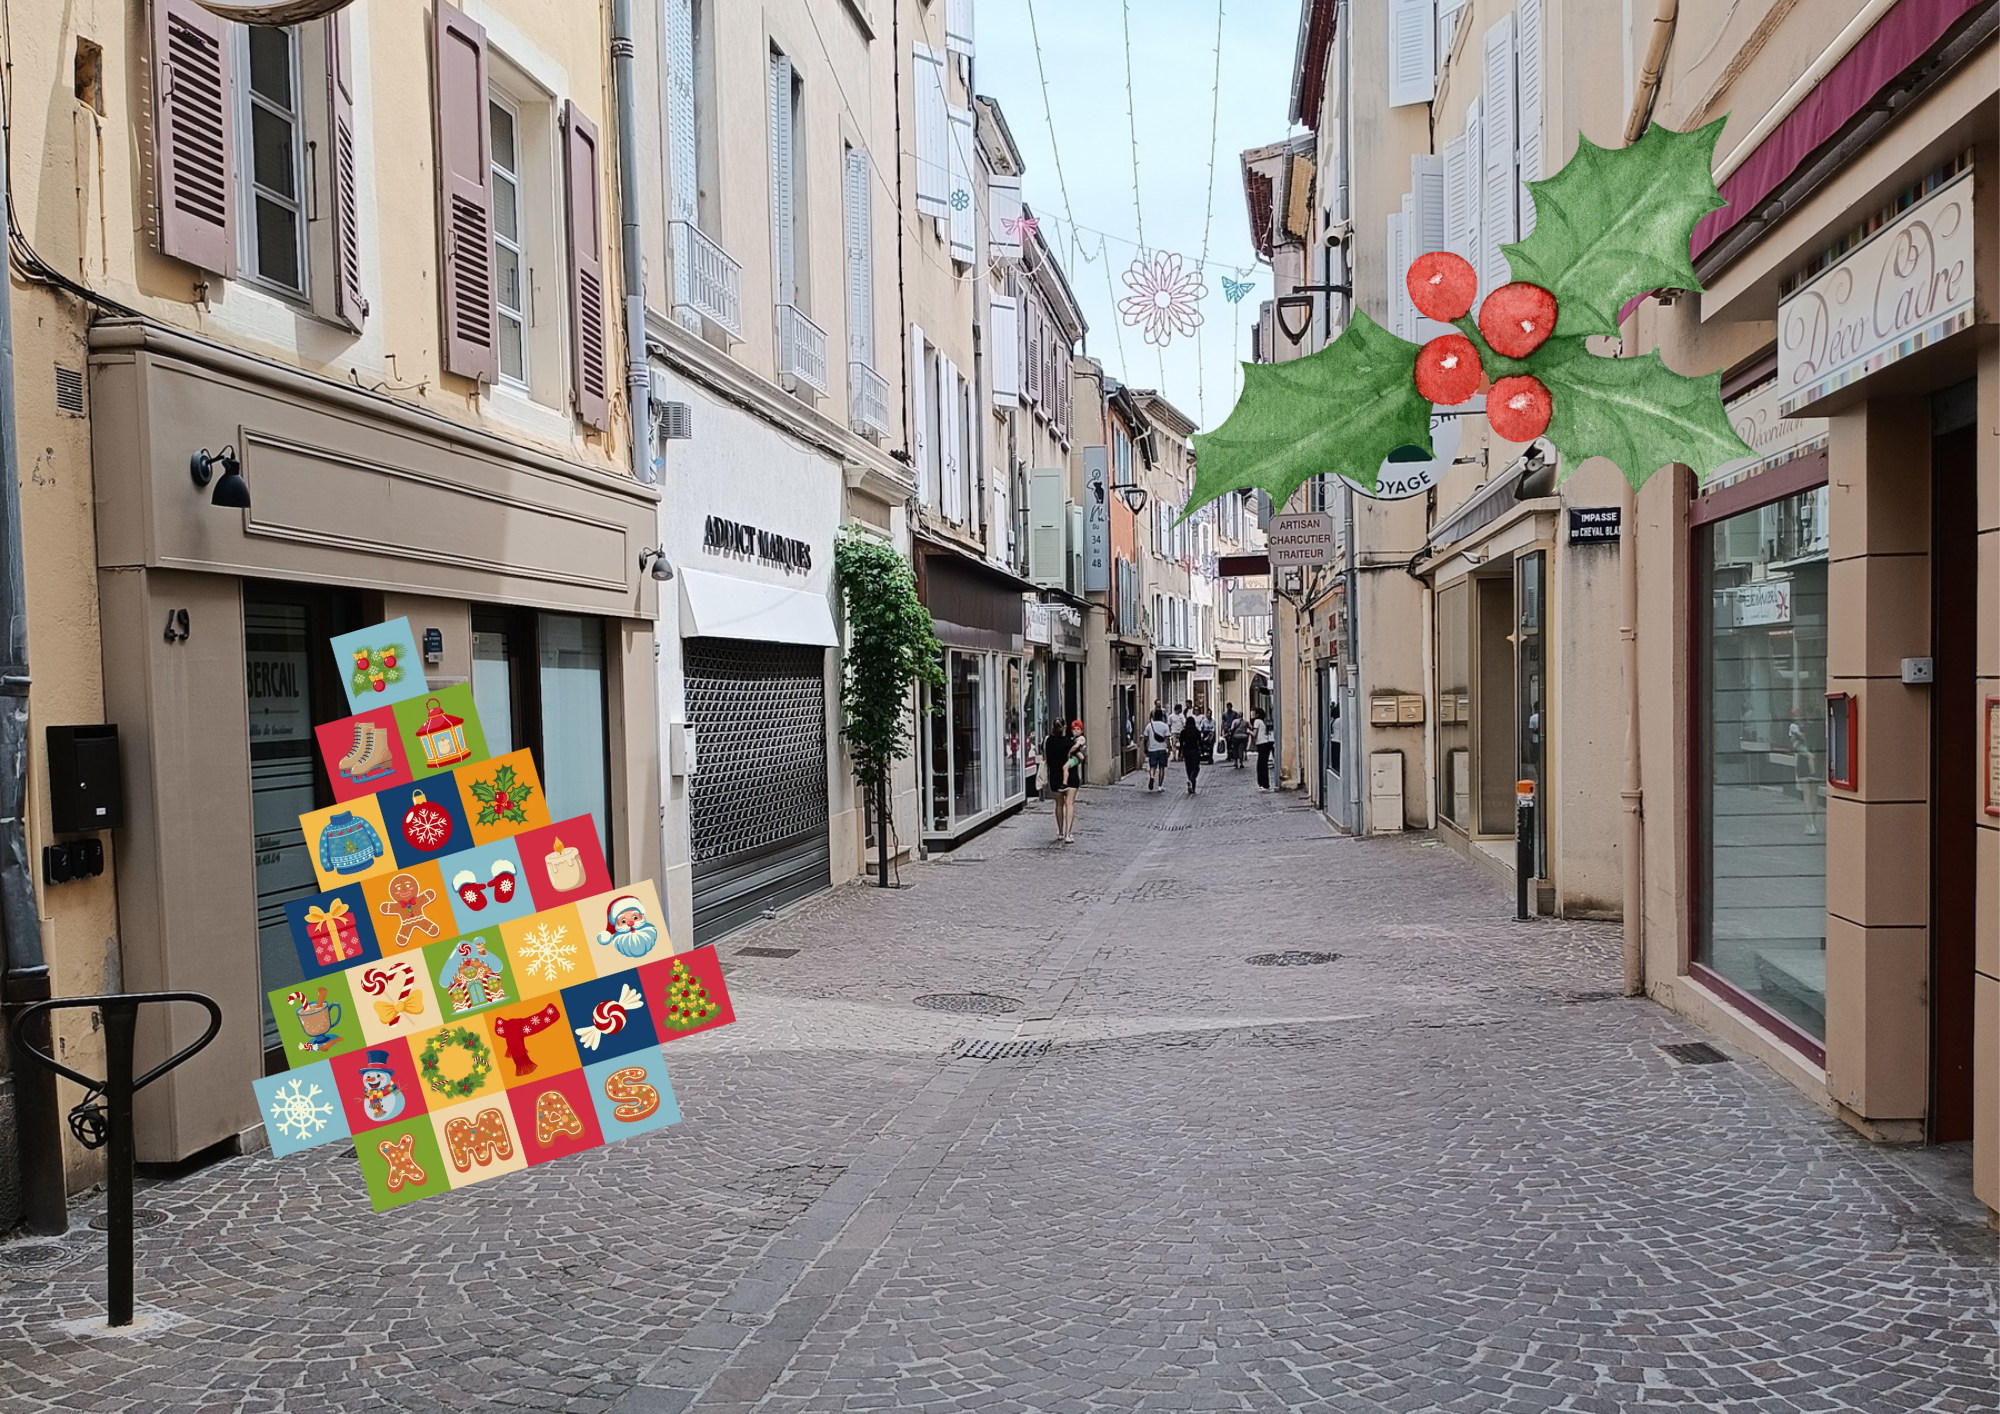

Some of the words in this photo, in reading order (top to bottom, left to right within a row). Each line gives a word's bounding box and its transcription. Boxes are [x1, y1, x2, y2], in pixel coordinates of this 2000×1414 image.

[1784, 267, 1869, 384] Déco
[1873, 202, 1964, 338] Cadre
[1362, 470, 1431, 495] OYAGE
[1581, 512, 1618, 523] IMPASSE
[1280, 519, 1320, 530] ARTISAN
[703, 514, 756, 555] ADDICT
[757, 529, 812, 570] MARQUES
[1091, 535, 1101, 544] 34
[1270, 534, 1331, 546] CHARCUTIER
[1278, 548, 1324, 560] TRAITEUR
[1091, 559, 1102, 568] 48
[163, 608, 190, 642] 49
